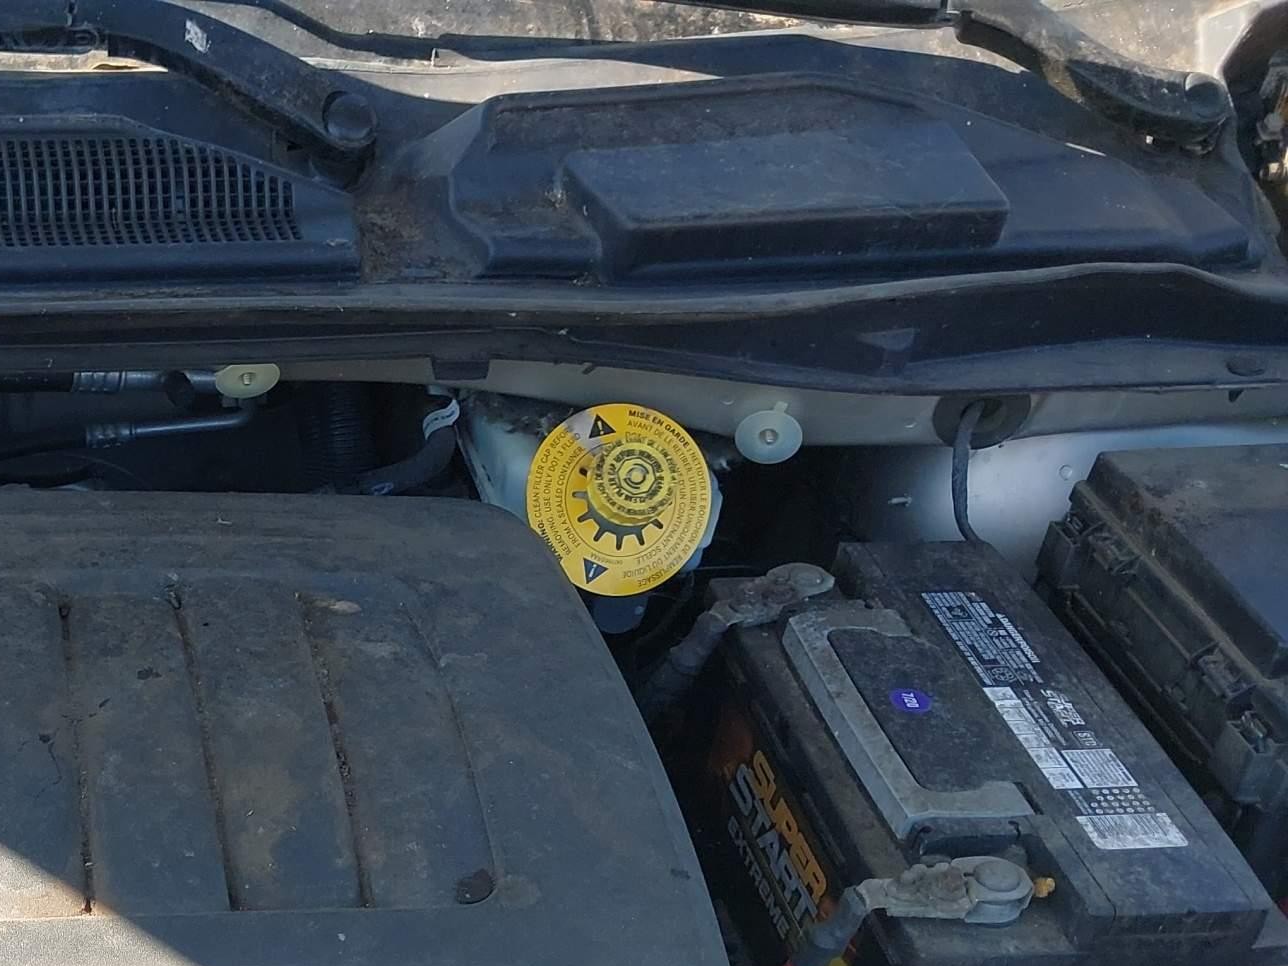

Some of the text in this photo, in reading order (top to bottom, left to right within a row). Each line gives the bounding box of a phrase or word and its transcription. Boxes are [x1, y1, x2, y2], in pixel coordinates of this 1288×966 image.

[627, 408, 652, 422] MISE
[650, 414, 665, 427] EN
[539, 446, 553, 464] CAP
[546, 455, 560, 473] DOT
[626, 417, 653, 433] AVANT
[686, 475, 698, 512] UTILISER
[531, 463, 545, 490] FILLER
[541, 472, 554, 494] ONLY
[532, 491, 542, 519] CLEAN
[542, 496, 552, 513] USE
[553, 486, 565, 520] SEALED
[699, 492, 707, 502] LE
[660, 501, 686, 549] CONTENANT
[687, 503, 706, 545] BOUCHON
[561, 525, 582, 549] FROM
[679, 542, 692, 557] DE
[729, 763, 818, 936] START
[728, 815, 790, 940] EXTREME
